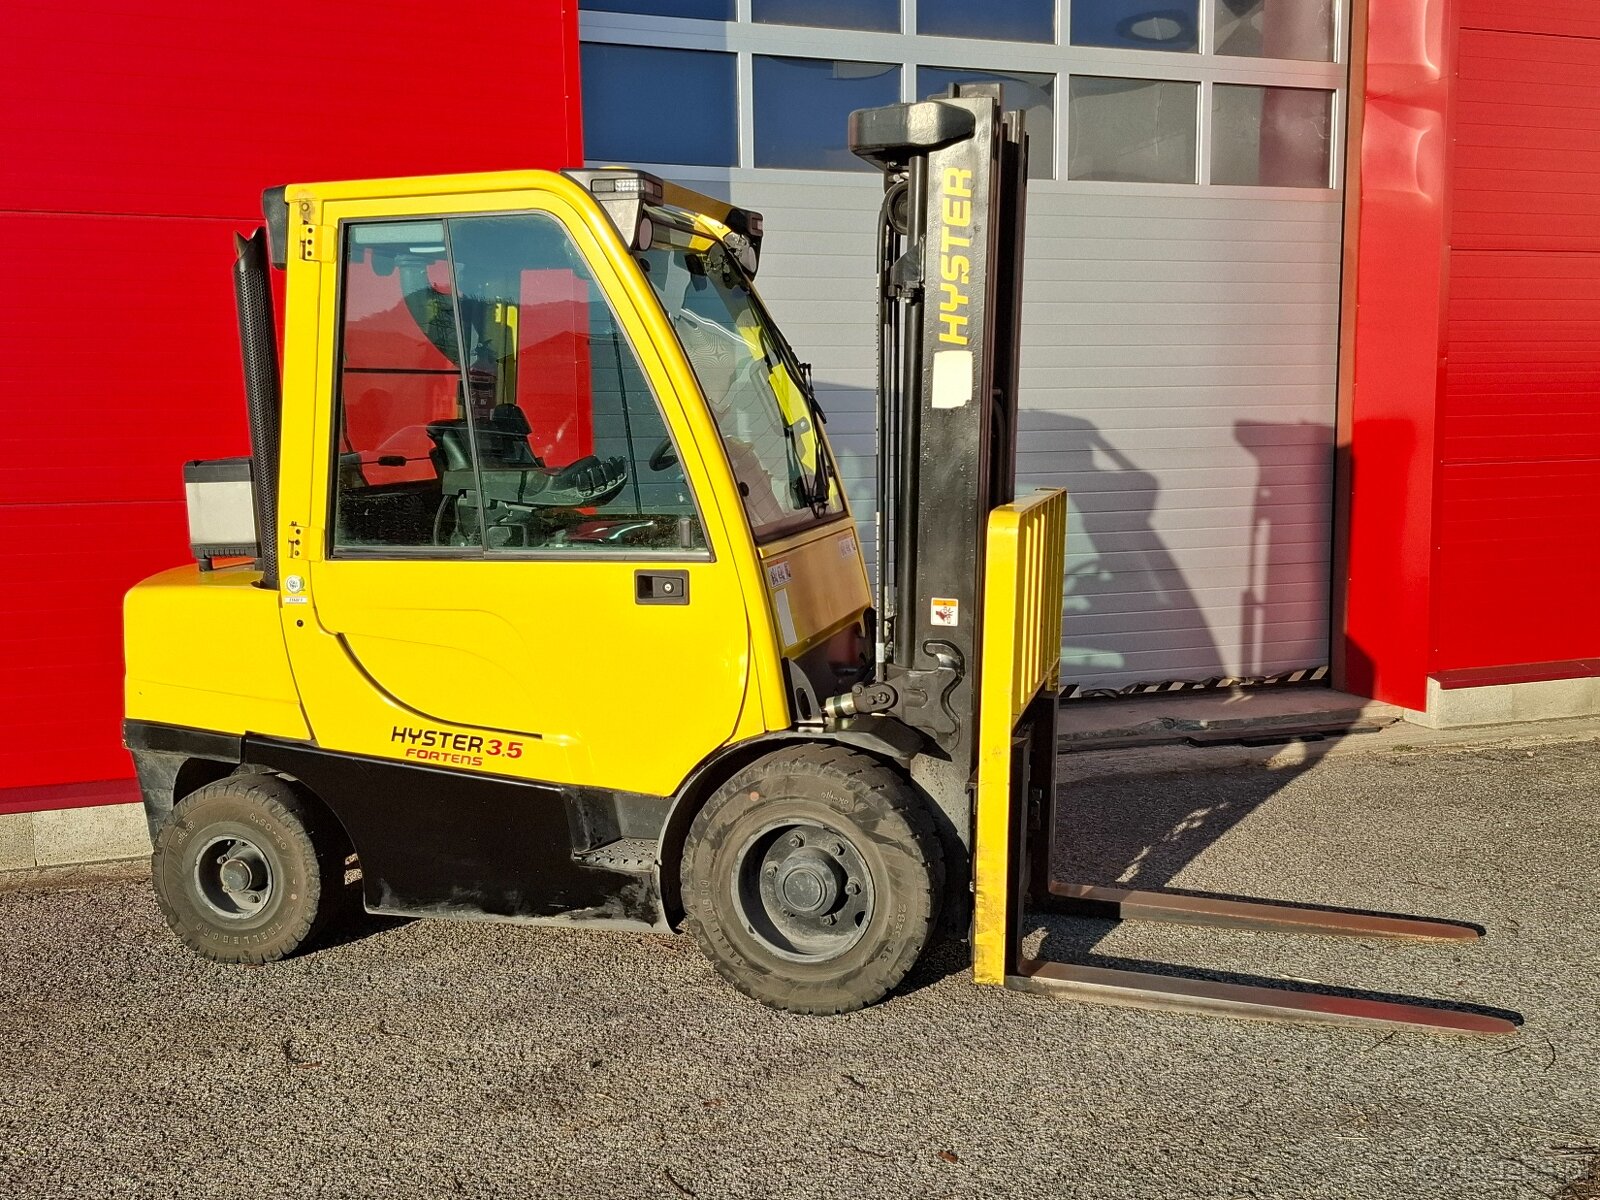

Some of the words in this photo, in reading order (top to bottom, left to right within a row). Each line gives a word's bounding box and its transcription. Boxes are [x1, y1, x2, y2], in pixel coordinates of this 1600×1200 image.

[939, 167, 972, 345] HYSTER
[391, 726, 484, 753] HYSTER
[486, 739, 524, 759] 3.5
[405, 748, 484, 766] FORTENS
